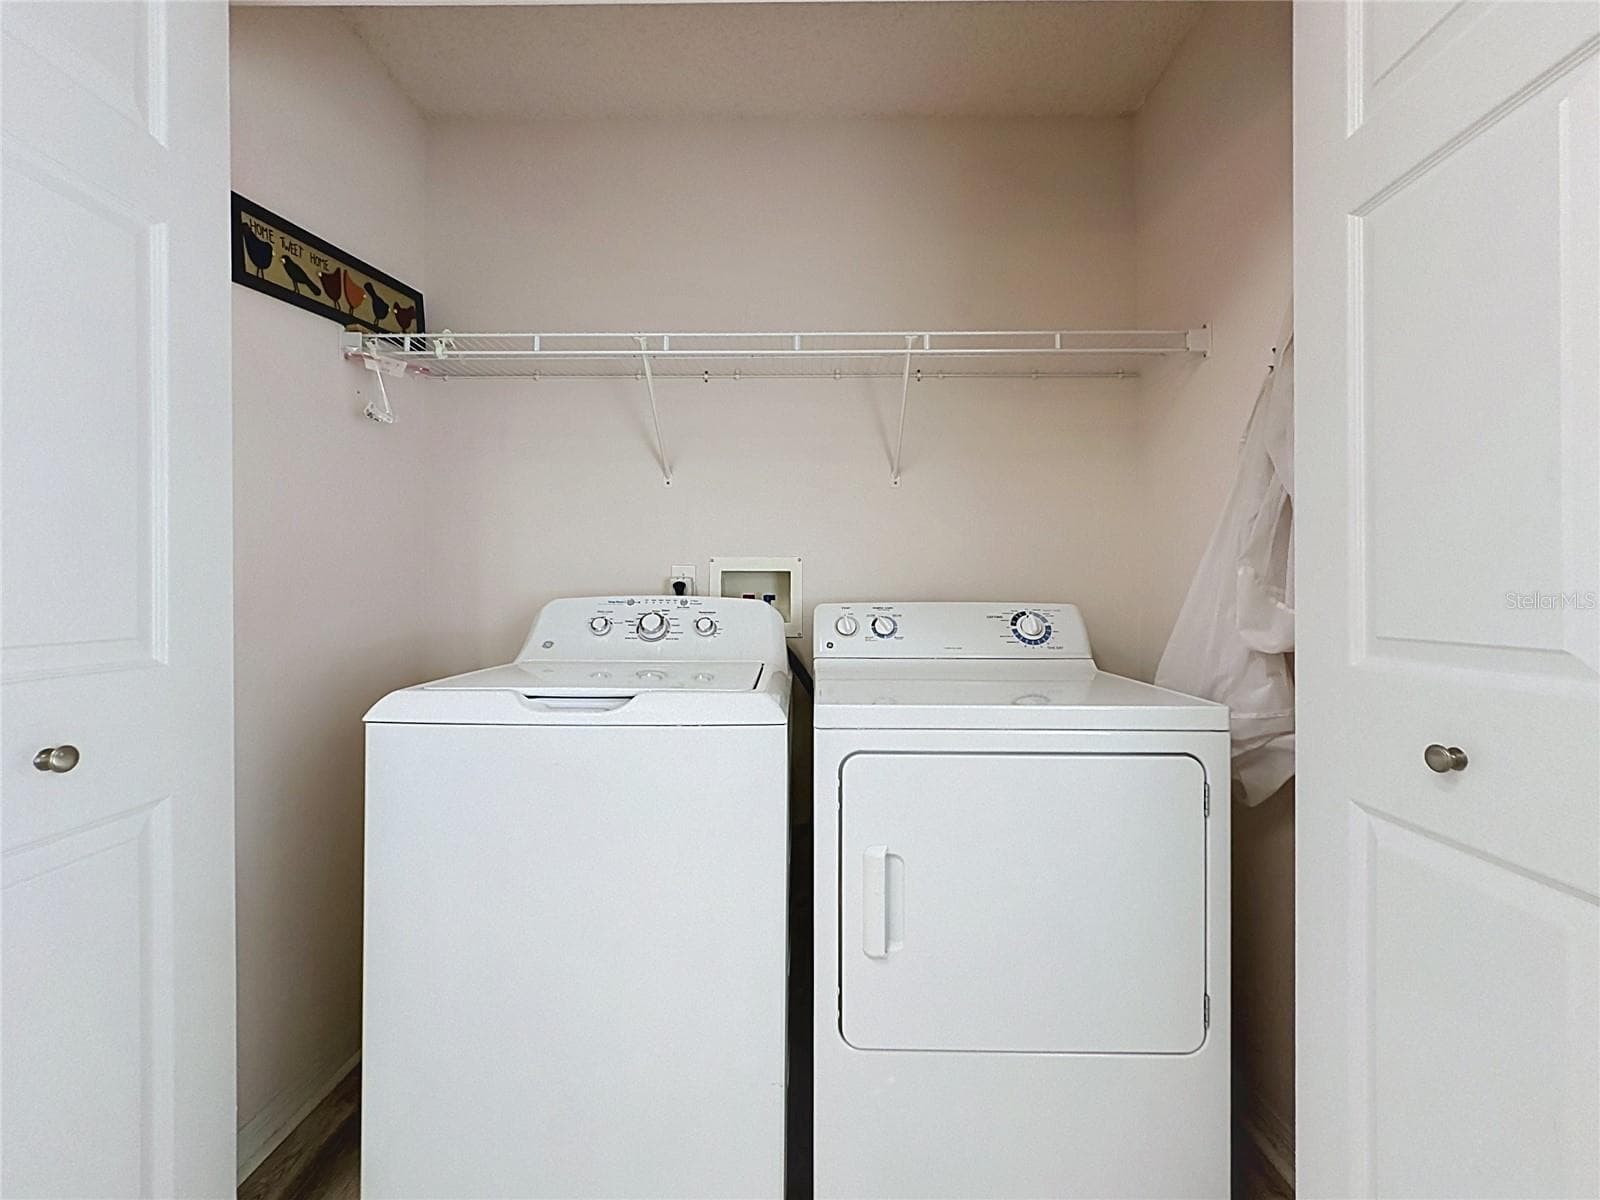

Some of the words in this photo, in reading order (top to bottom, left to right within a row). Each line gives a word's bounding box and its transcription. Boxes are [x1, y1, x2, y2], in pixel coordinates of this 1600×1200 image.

[249, 218, 274, 244] HOME
[279, 236, 304, 257] TWEET
[309, 252, 330, 273] HOME
